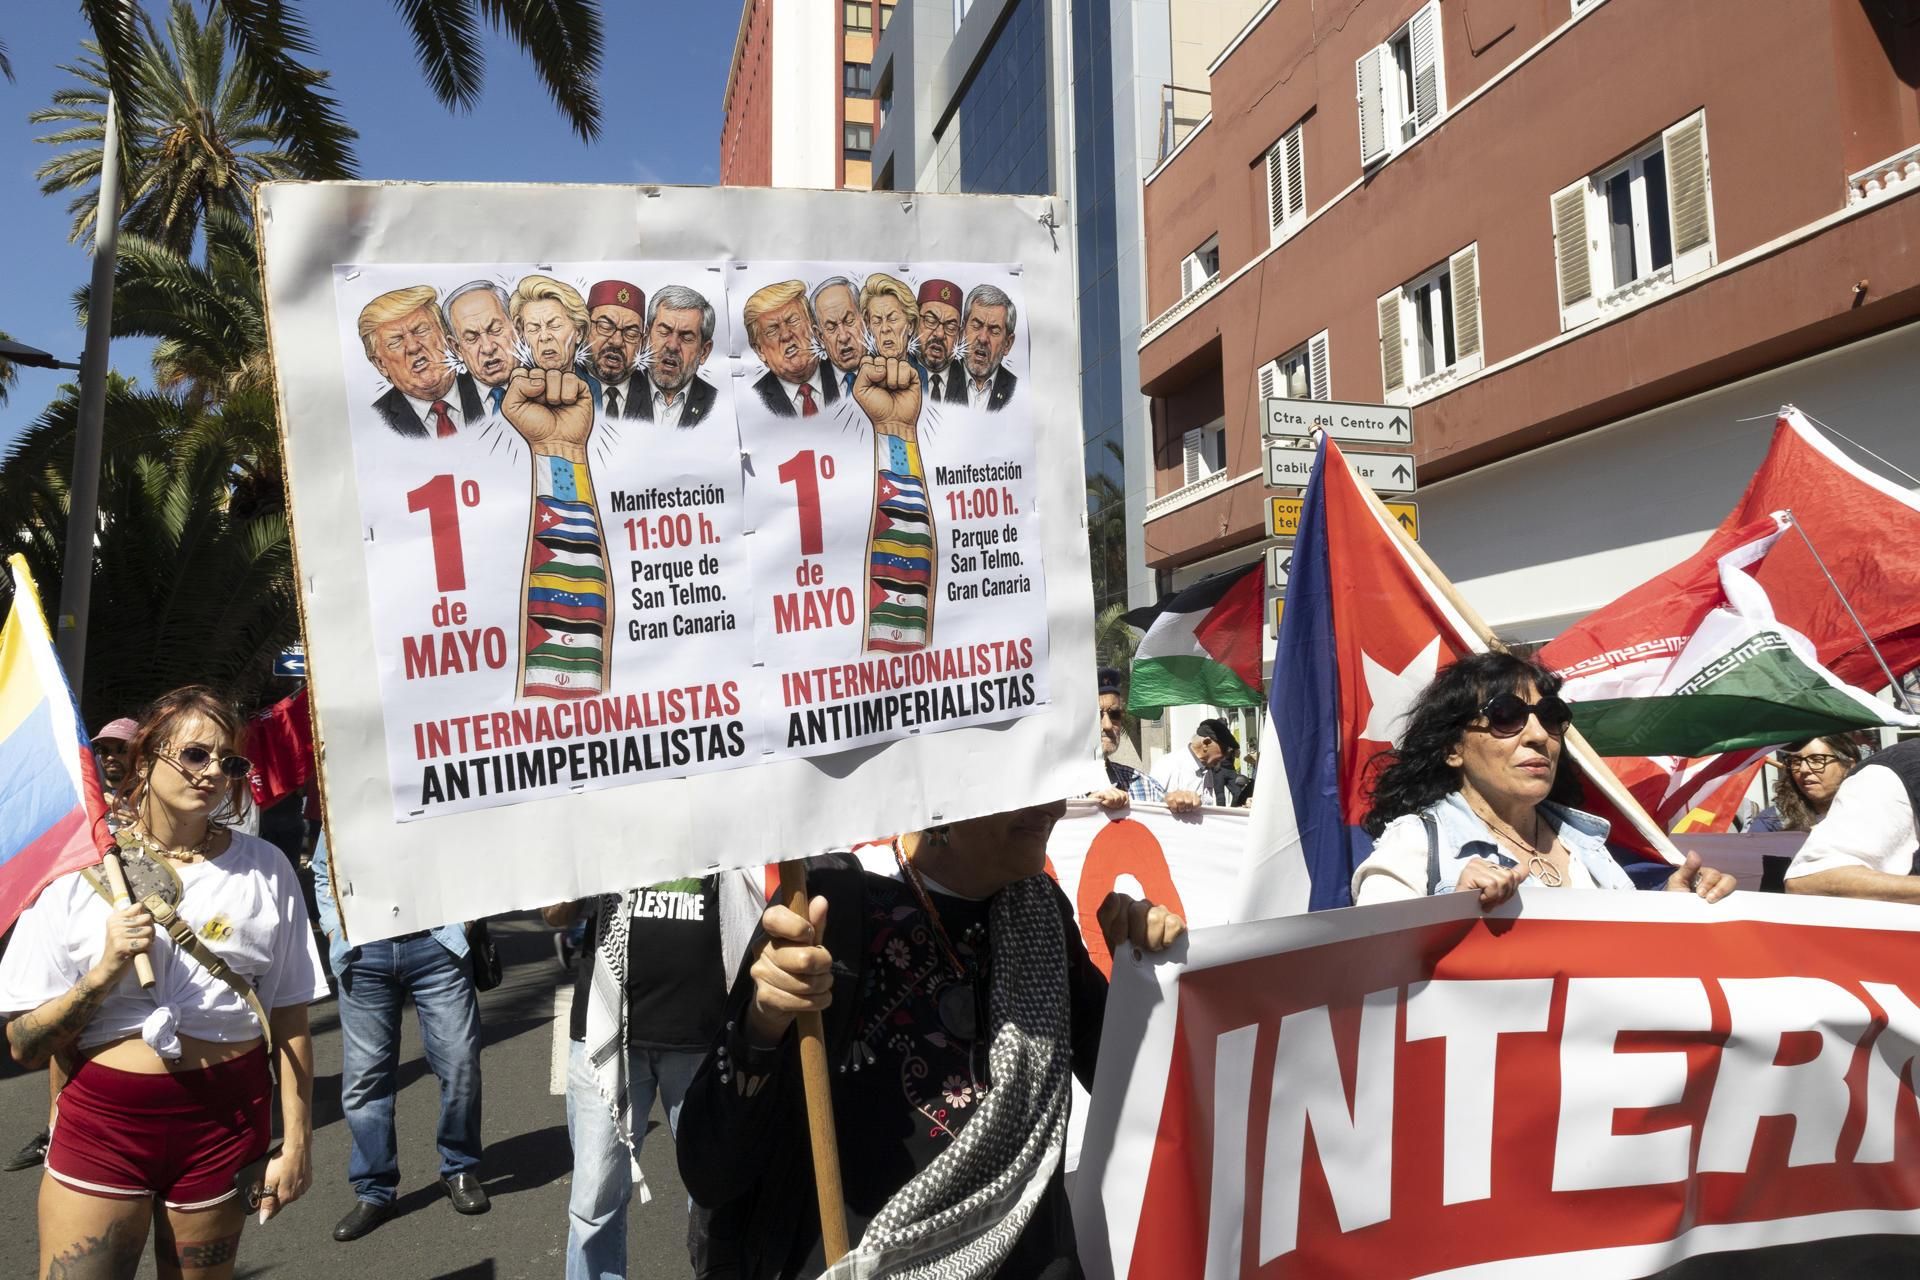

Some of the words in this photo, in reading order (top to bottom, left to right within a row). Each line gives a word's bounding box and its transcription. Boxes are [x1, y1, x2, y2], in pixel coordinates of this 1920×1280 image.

[1273, 411, 1306, 425] Ctra.
[1313, 414, 1334, 427] del
[1340, 416, 1384, 431] Centro
[936, 461, 1022, 486] Manifestación
[1355, 465, 1375, 477] lar
[610, 484, 725, 513] Manifestación
[946, 488, 1000, 521] 11:00
[1002, 486, 1019, 515] h.
[623, 513, 692, 551] 11:00
[698, 512, 721, 545] h.
[951, 528, 999, 549] Parque
[1003, 524, 1018, 543] de
[631, 558, 696, 582] Parque
[698, 554, 720, 575] de
[796, 559, 824, 587] de
[951, 553, 977, 574] San
[980, 549, 1024, 571] Telmo.
[631, 587, 665, 611] San
[668, 582, 726, 606] Telmo.
[947, 581, 979, 602] Gran
[982, 574, 1031, 596] Canaria
[431, 597, 468, 628] de
[773, 586, 855, 634] MAYO
[628, 618, 669, 642] Gran
[673, 610, 736, 637] Canaria
[402, 626, 508, 681] MAYO
[781, 637, 1034, 708] INTERNACIONALISTAS
[413, 680, 741, 760] INTERNACIONALISTAS
[787, 673, 1036, 748] ANTIIMPERIALISTAS
[421, 720, 745, 805] ANTIIMPERIALISTAS
[632, 890, 704, 920] LESTINE
